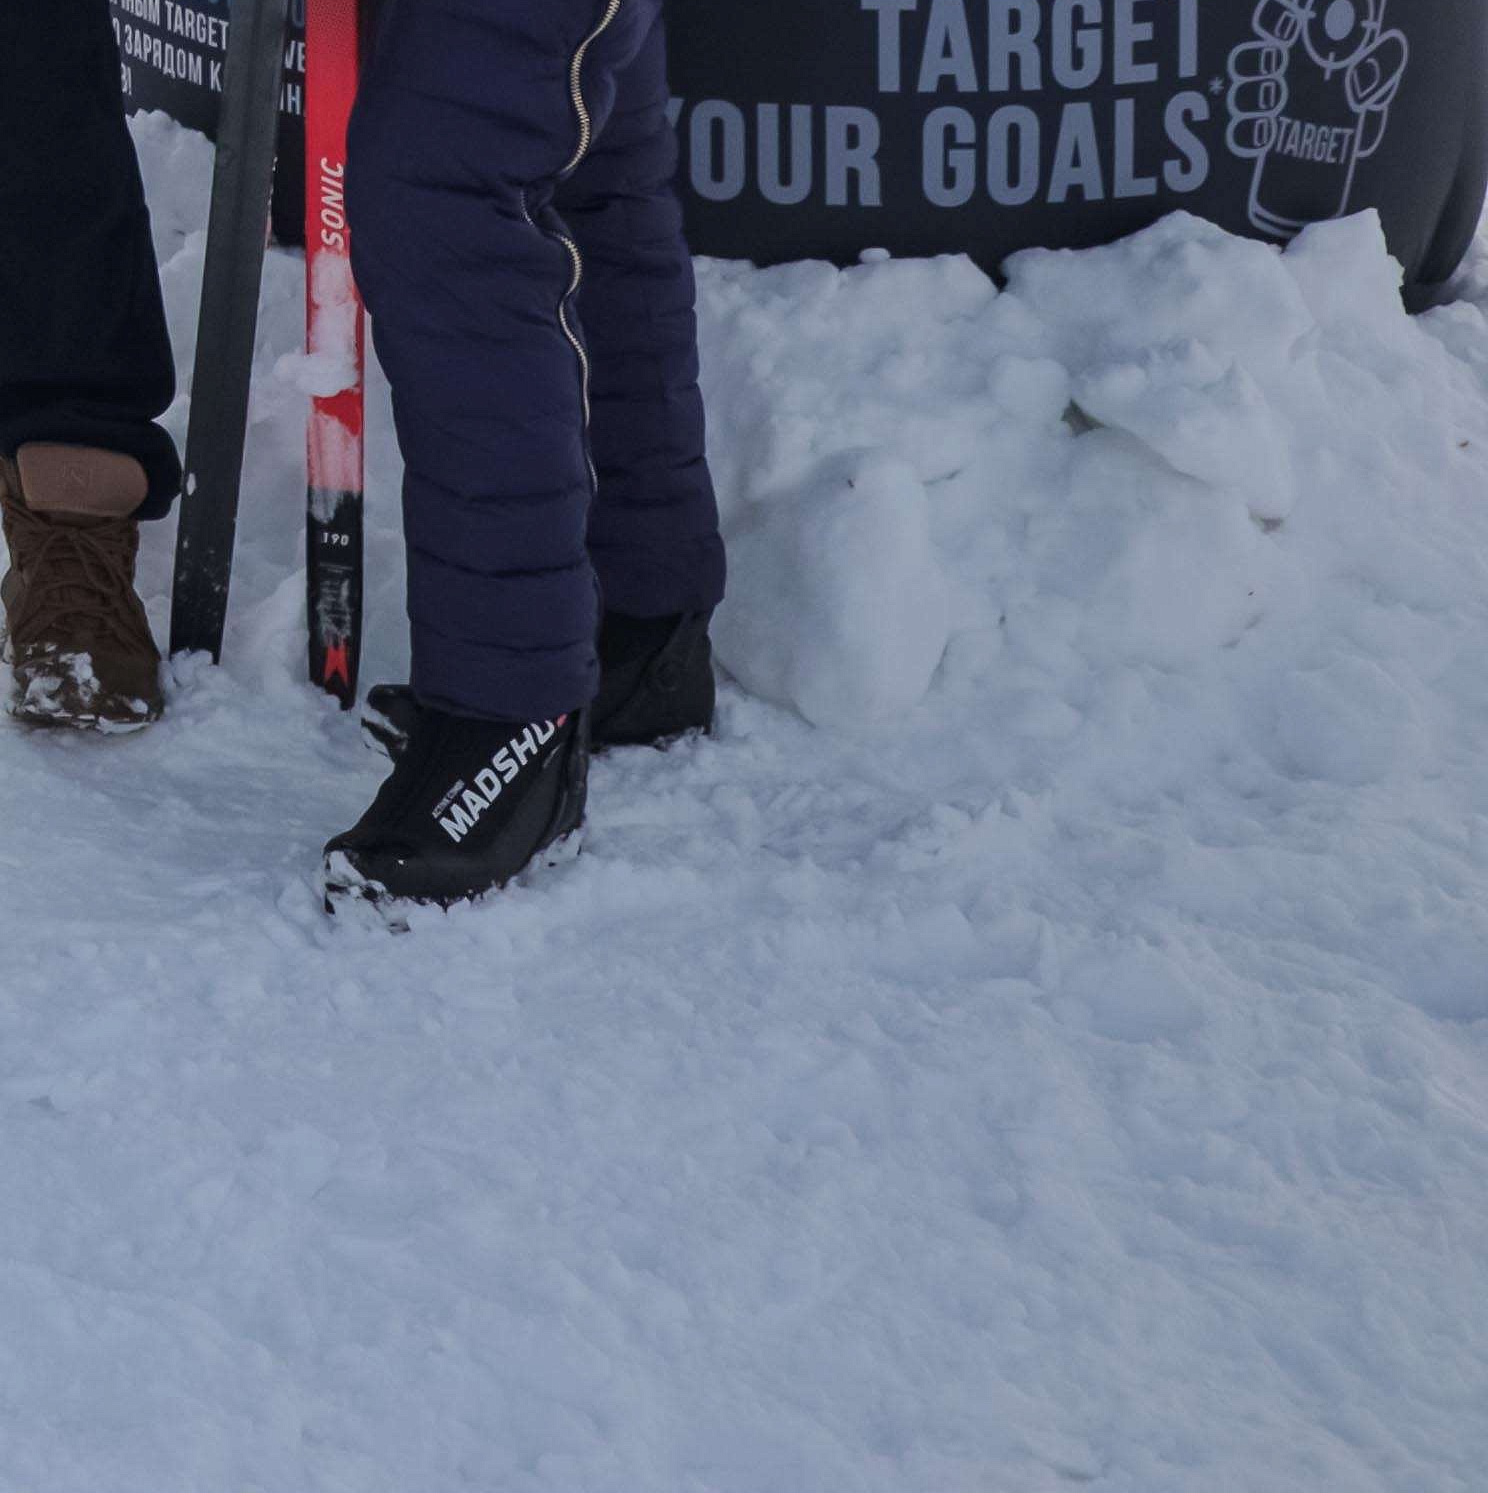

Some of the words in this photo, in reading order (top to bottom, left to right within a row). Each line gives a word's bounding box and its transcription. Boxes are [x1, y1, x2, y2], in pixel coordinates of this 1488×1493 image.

[164, 0, 230, 50] TARGET
[124, 24, 203, 86] ЗАРЯДОМ
[1271, 118, 1356, 165] TARGET
[320, 156, 344, 250] SONIC
[322, 531, 350, 547] 190
[439, 719, 556, 844] MADSHU
